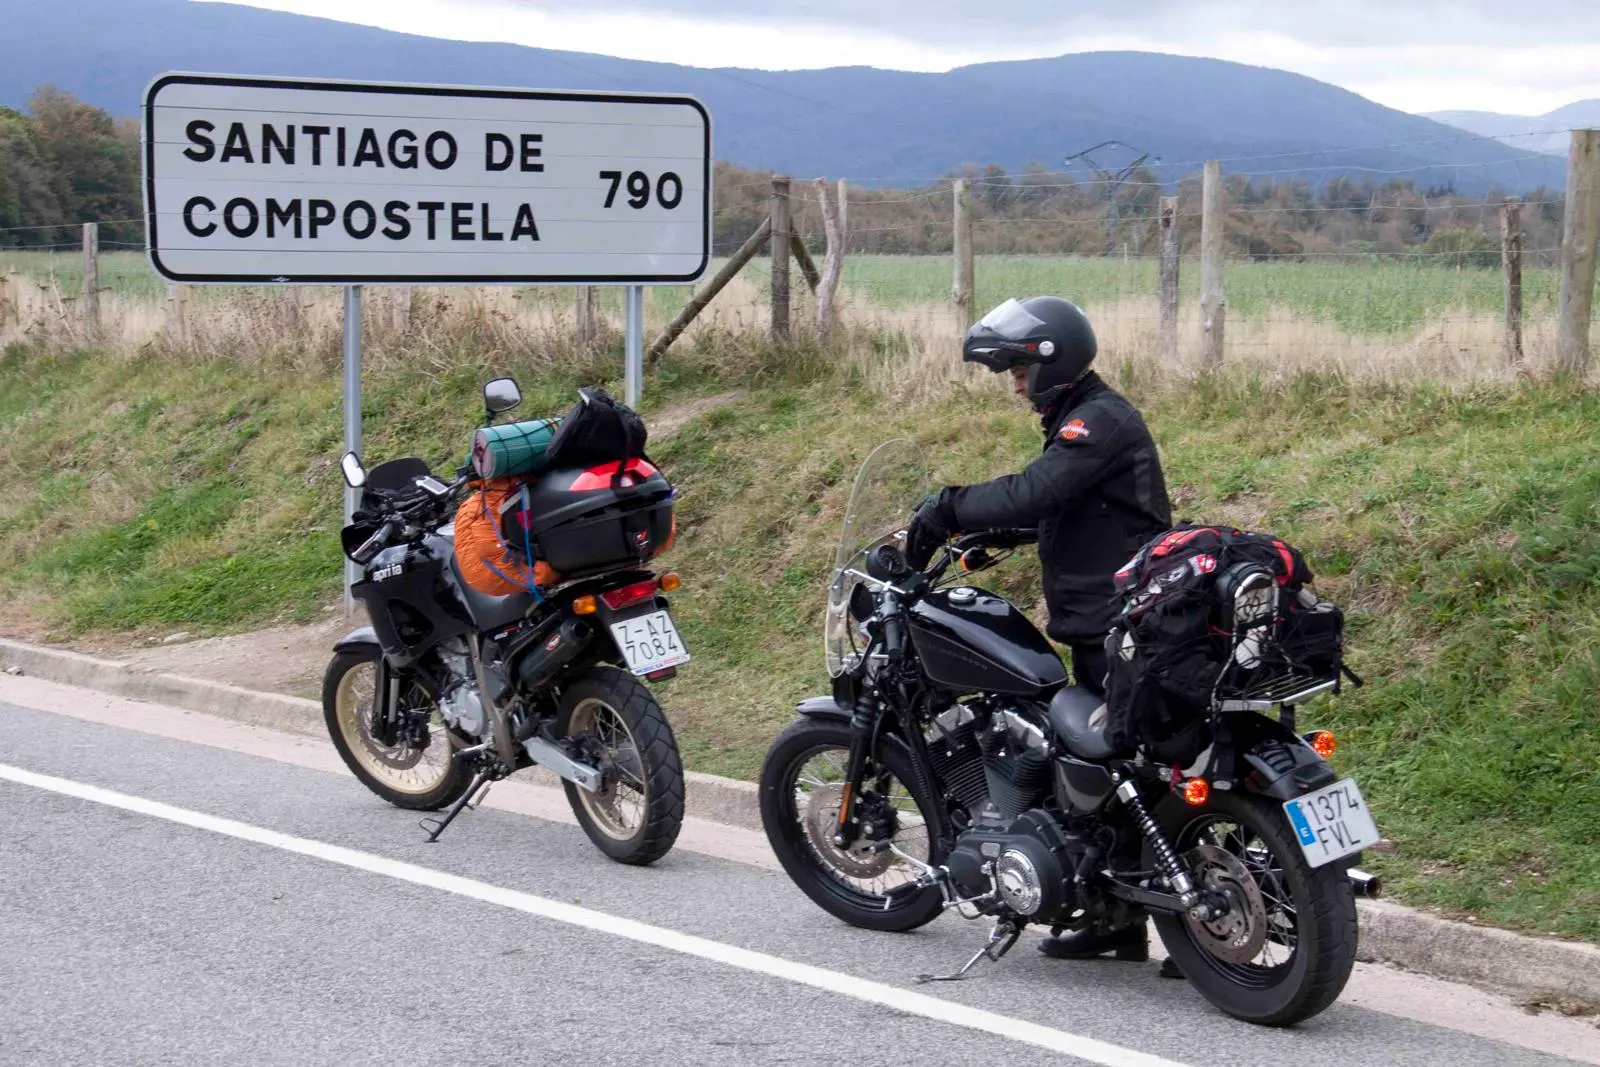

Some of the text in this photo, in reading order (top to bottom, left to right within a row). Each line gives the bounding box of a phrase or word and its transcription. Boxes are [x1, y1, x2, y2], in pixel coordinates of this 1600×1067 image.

[182, 119, 544, 173] SANTIAGO DE
[599, 170, 683, 210] 790
[182, 195, 540, 242] COMPOSTELA
[372, 563, 403, 582] apriia
[618, 615, 672, 644] Z-AZ
[626, 634, 677, 664] 7084
[1308, 786, 1359, 825] 1374
[1300, 827, 1309, 837] E
[1316, 820, 1361, 855] FVL
